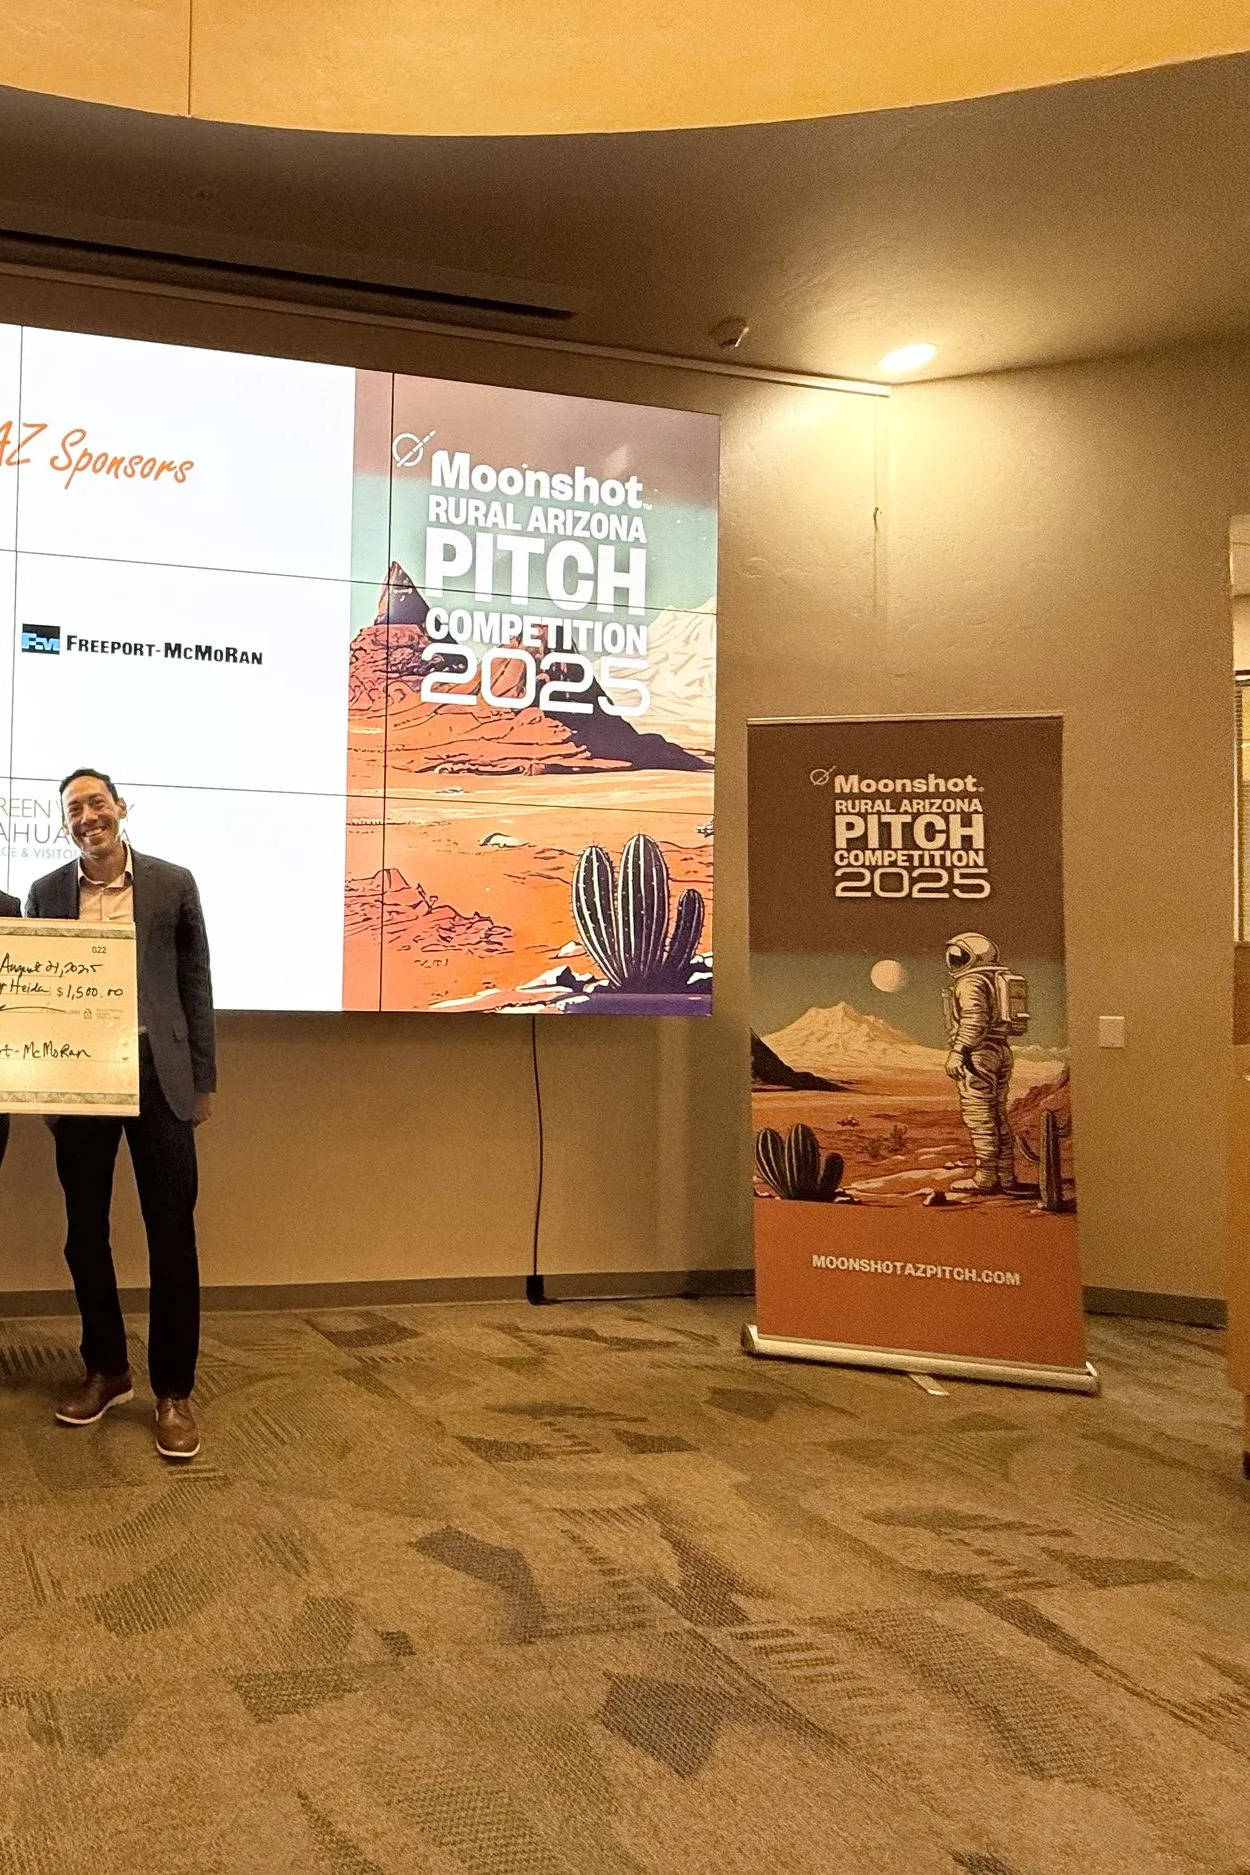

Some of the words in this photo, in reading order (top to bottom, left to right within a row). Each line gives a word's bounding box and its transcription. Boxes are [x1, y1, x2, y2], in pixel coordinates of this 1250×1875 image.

[49, 428, 195, 489] Sponsors
[431, 450, 643, 509] Moonshot
[428, 495, 522, 531] RURAL
[527, 505, 647, 544] ARIZONA
[425, 526, 646, 616] PITCH
[425, 607, 647, 656] COMPETITION
[420, 642, 651, 717] 2025
[834, 773, 978, 793] Moonshot
[835, 799, 896, 813] RURAL
[900, 798, 983, 813] ARIZONA
[835, 813, 985, 850] PITCH
[21, 848, 29, 858] &
[834, 850, 984, 867] COMPETITION
[835, 867, 991, 899] 2025
[92, 946, 106, 954] 022
[812, 1254, 1021, 1286] MOONSHOTAZPITCH.COM
